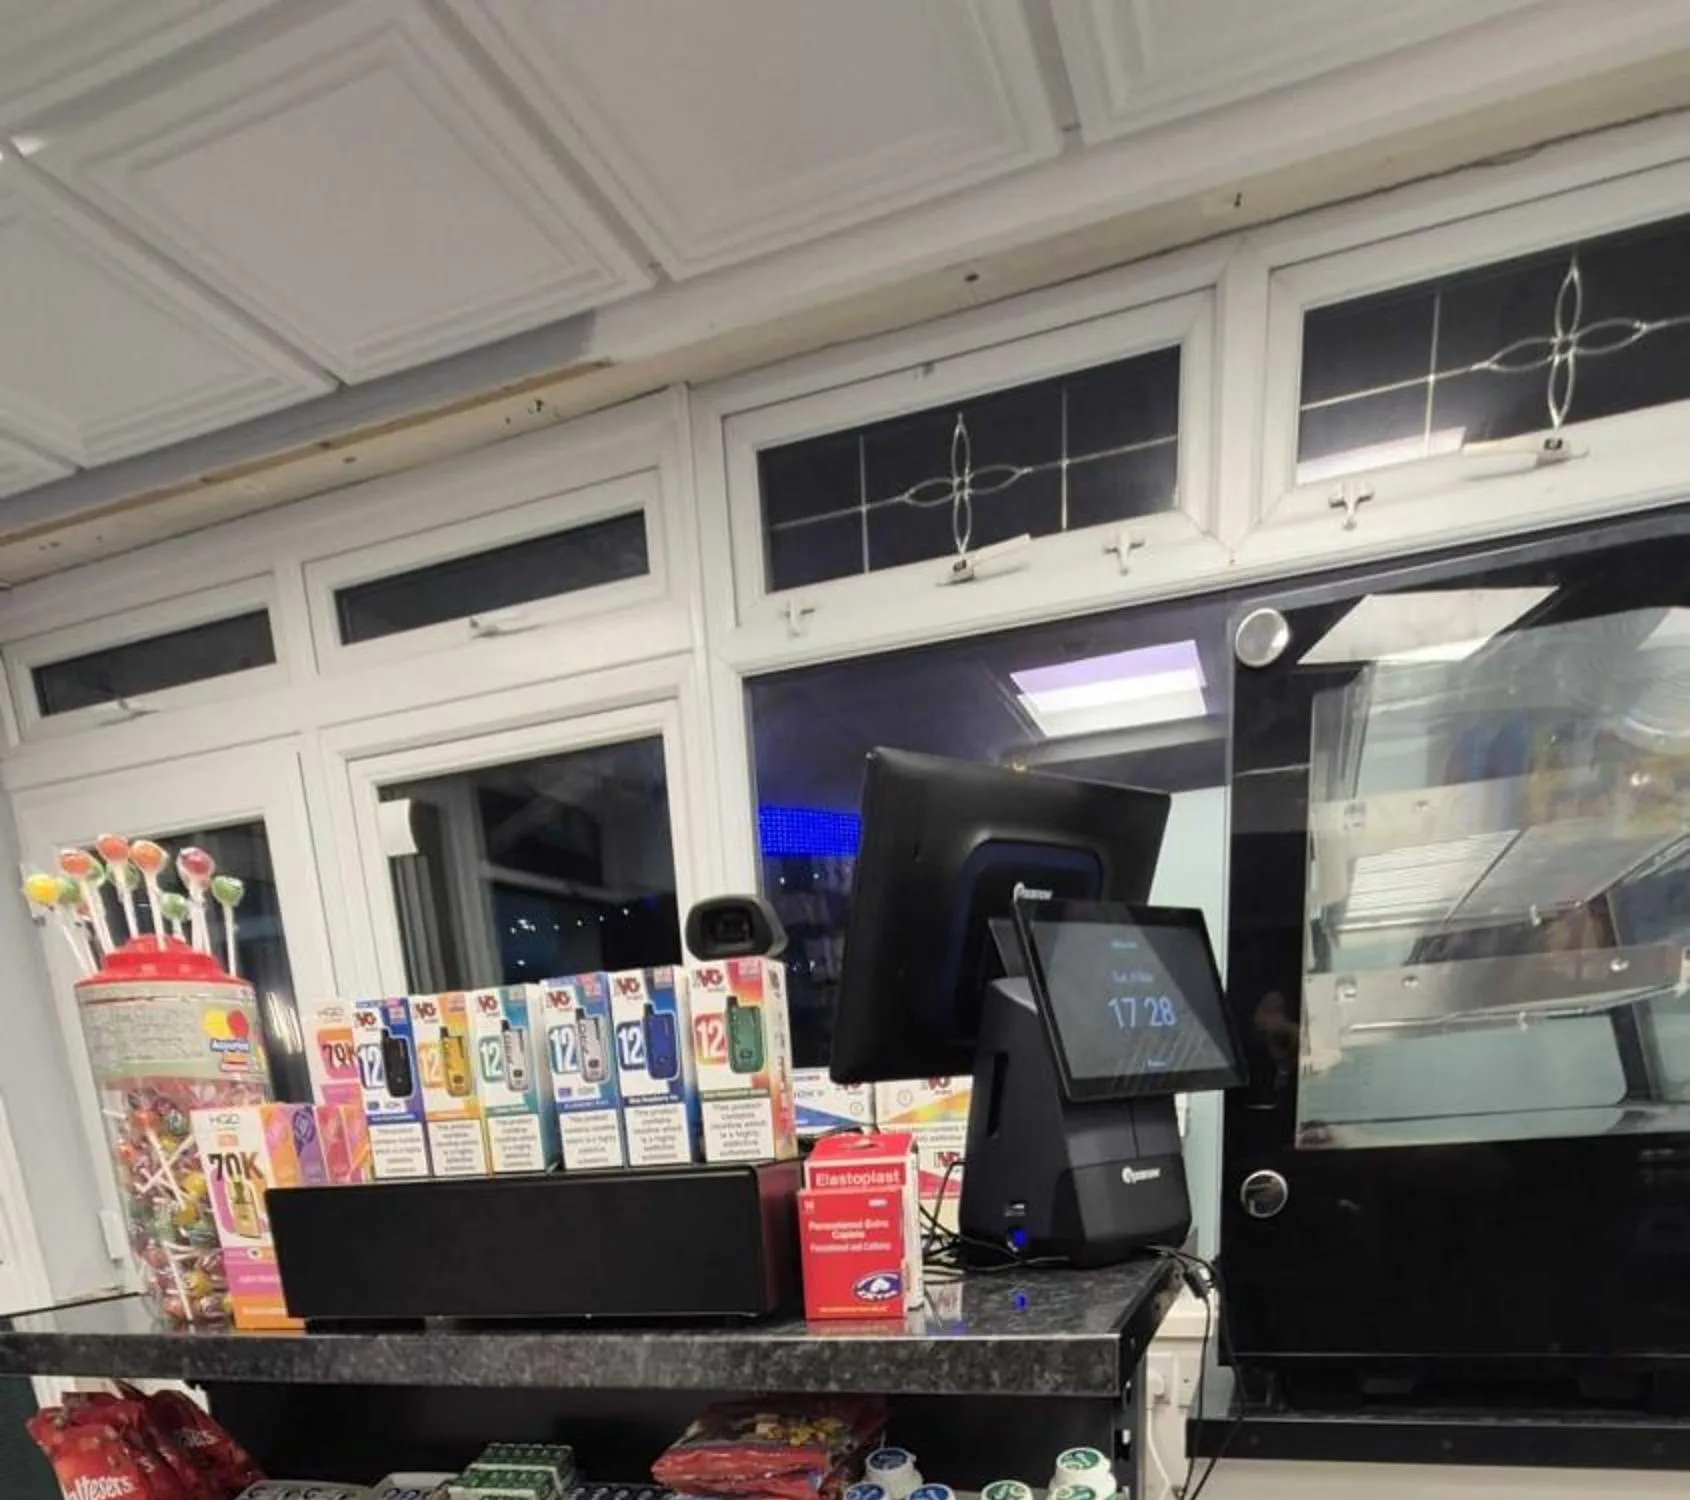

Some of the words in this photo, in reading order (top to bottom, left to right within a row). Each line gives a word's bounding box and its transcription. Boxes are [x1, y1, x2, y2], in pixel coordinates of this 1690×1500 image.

[550, 1027, 579, 1073] 12
[619, 1026, 645, 1066] 12
[697, 1019, 727, 1059] 12
[358, 1045, 385, 1087] 12
[480, 1041, 502, 1078] 12
[209, 1152, 264, 1182] 70K
[815, 1169, 900, 1187] Elastoplast
